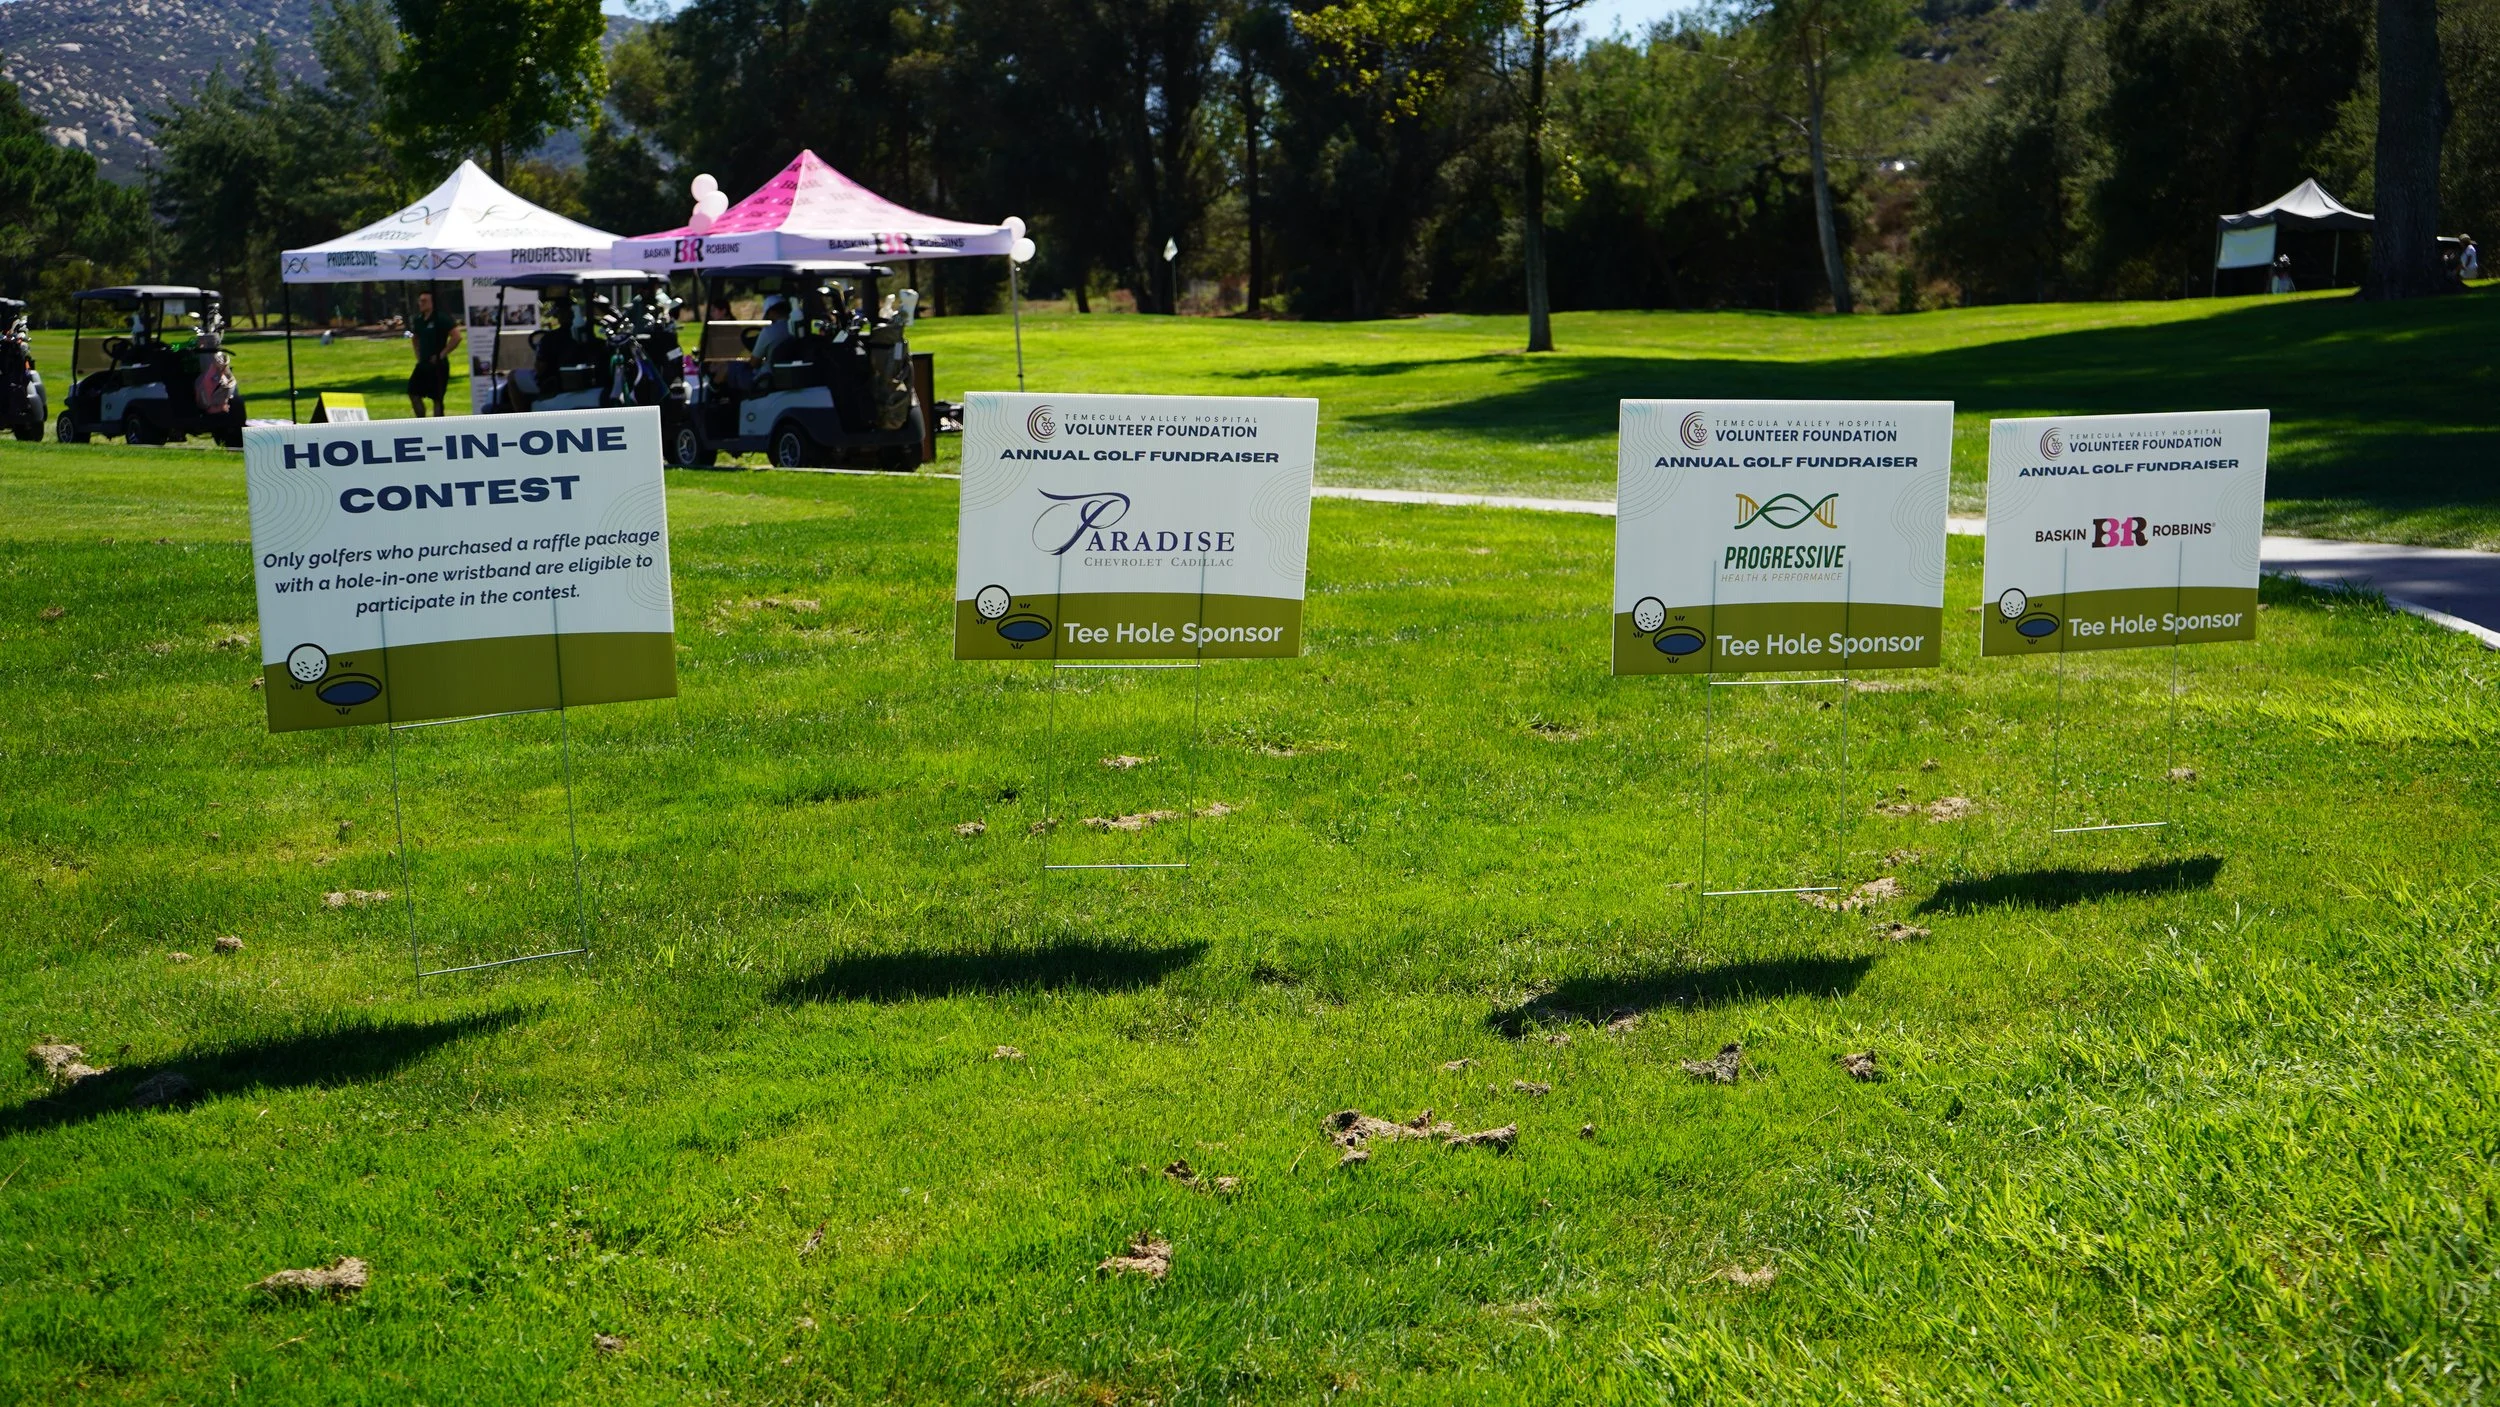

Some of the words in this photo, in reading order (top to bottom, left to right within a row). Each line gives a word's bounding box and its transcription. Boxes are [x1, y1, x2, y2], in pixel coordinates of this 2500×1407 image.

[511, 247, 592, 263] PROGRESSIVE
[644, 248, 671, 258] BASKIN
[706, 243, 740, 253] ROBBINS
[327, 251, 378, 267] PROGRESSIVE
[1065, 413, 1132, 421] TEMECULA
[1065, 423, 1152, 437] VOLUNTEER
[1157, 425, 1258, 438] FOUNDATION
[1715, 430, 1799, 442] VOLUNTEER
[1803, 430, 1897, 442] FOUNDATION
[2070, 432, 2123, 440] TEMECULA
[2130, 430, 2166, 438] VALLEY
[2173, 428, 2222, 436] HOSPITAL
[283, 426, 627, 469] HOLE-IN-ONE
[2070, 440, 2139, 453] VOLUNTEER
[2142, 437, 2222, 450] FOUNDATION
[1000, 449, 1090, 461] ANNUAL
[1093, 451, 1146, 462] GOLF
[1150, 452, 1279, 463] FUNDRAISER
[1655, 457, 1741, 468] ANNUAL
[1743, 457, 1794, 468] GOLF
[1797, 457, 1918, 468] FUNDRAISER
[2018, 466, 2090, 477] ANNUAL
[2092, 463, 2134, 474] GOLF
[2137, 459, 2239, 472] FUNDRAISER
[340, 475, 580, 513] CONTEST
[1032, 488, 1235, 556] PARADISE
[2035, 528, 2087, 543] BASKIN
[263, 553, 305, 568] Only
[309, 545, 373, 569] golfers
[377, 545, 414, 561] who
[418, 537, 513, 562] purchased
[517, 540, 529, 551] a
[533, 533, 580, 550] raffle
[584, 529, 660, 549] package
[1724, 545, 1846, 569] PROGRESSIVE
[1084, 557, 1162, 567] CHEVROLET
[275, 577, 314, 594] with
[318, 579, 331, 590] a
[335, 570, 439, 590] hole-in-one
[443, 564, 531, 581] wristband
[535, 563, 564, 575] are
[568, 555, 631, 574] eligible
[636, 554, 653, 568] to
[1721, 573, 1759, 582] HEALTH
[1762, 573, 1767, 582] &
[1772, 573, 1843, 582] PERFORMANCE
[356, 594, 455, 618] participate
[459, 592, 476, 606] in
[480, 589, 508, 605] the
[512, 584, 580, 603] contest.
[2069, 618, 2105, 636] Tee
[2110, 614, 2157, 634] Hole
[2162, 611, 2242, 634] Sponsor
[1064, 623, 1109, 643] Tee
[1116, 623, 1175, 643] Hole
[1182, 623, 1283, 648] Sponsor
[1717, 635, 1759, 656] Tee
[1767, 634, 1823, 655] Hole
[1828, 632, 1924, 658] Sponsor
